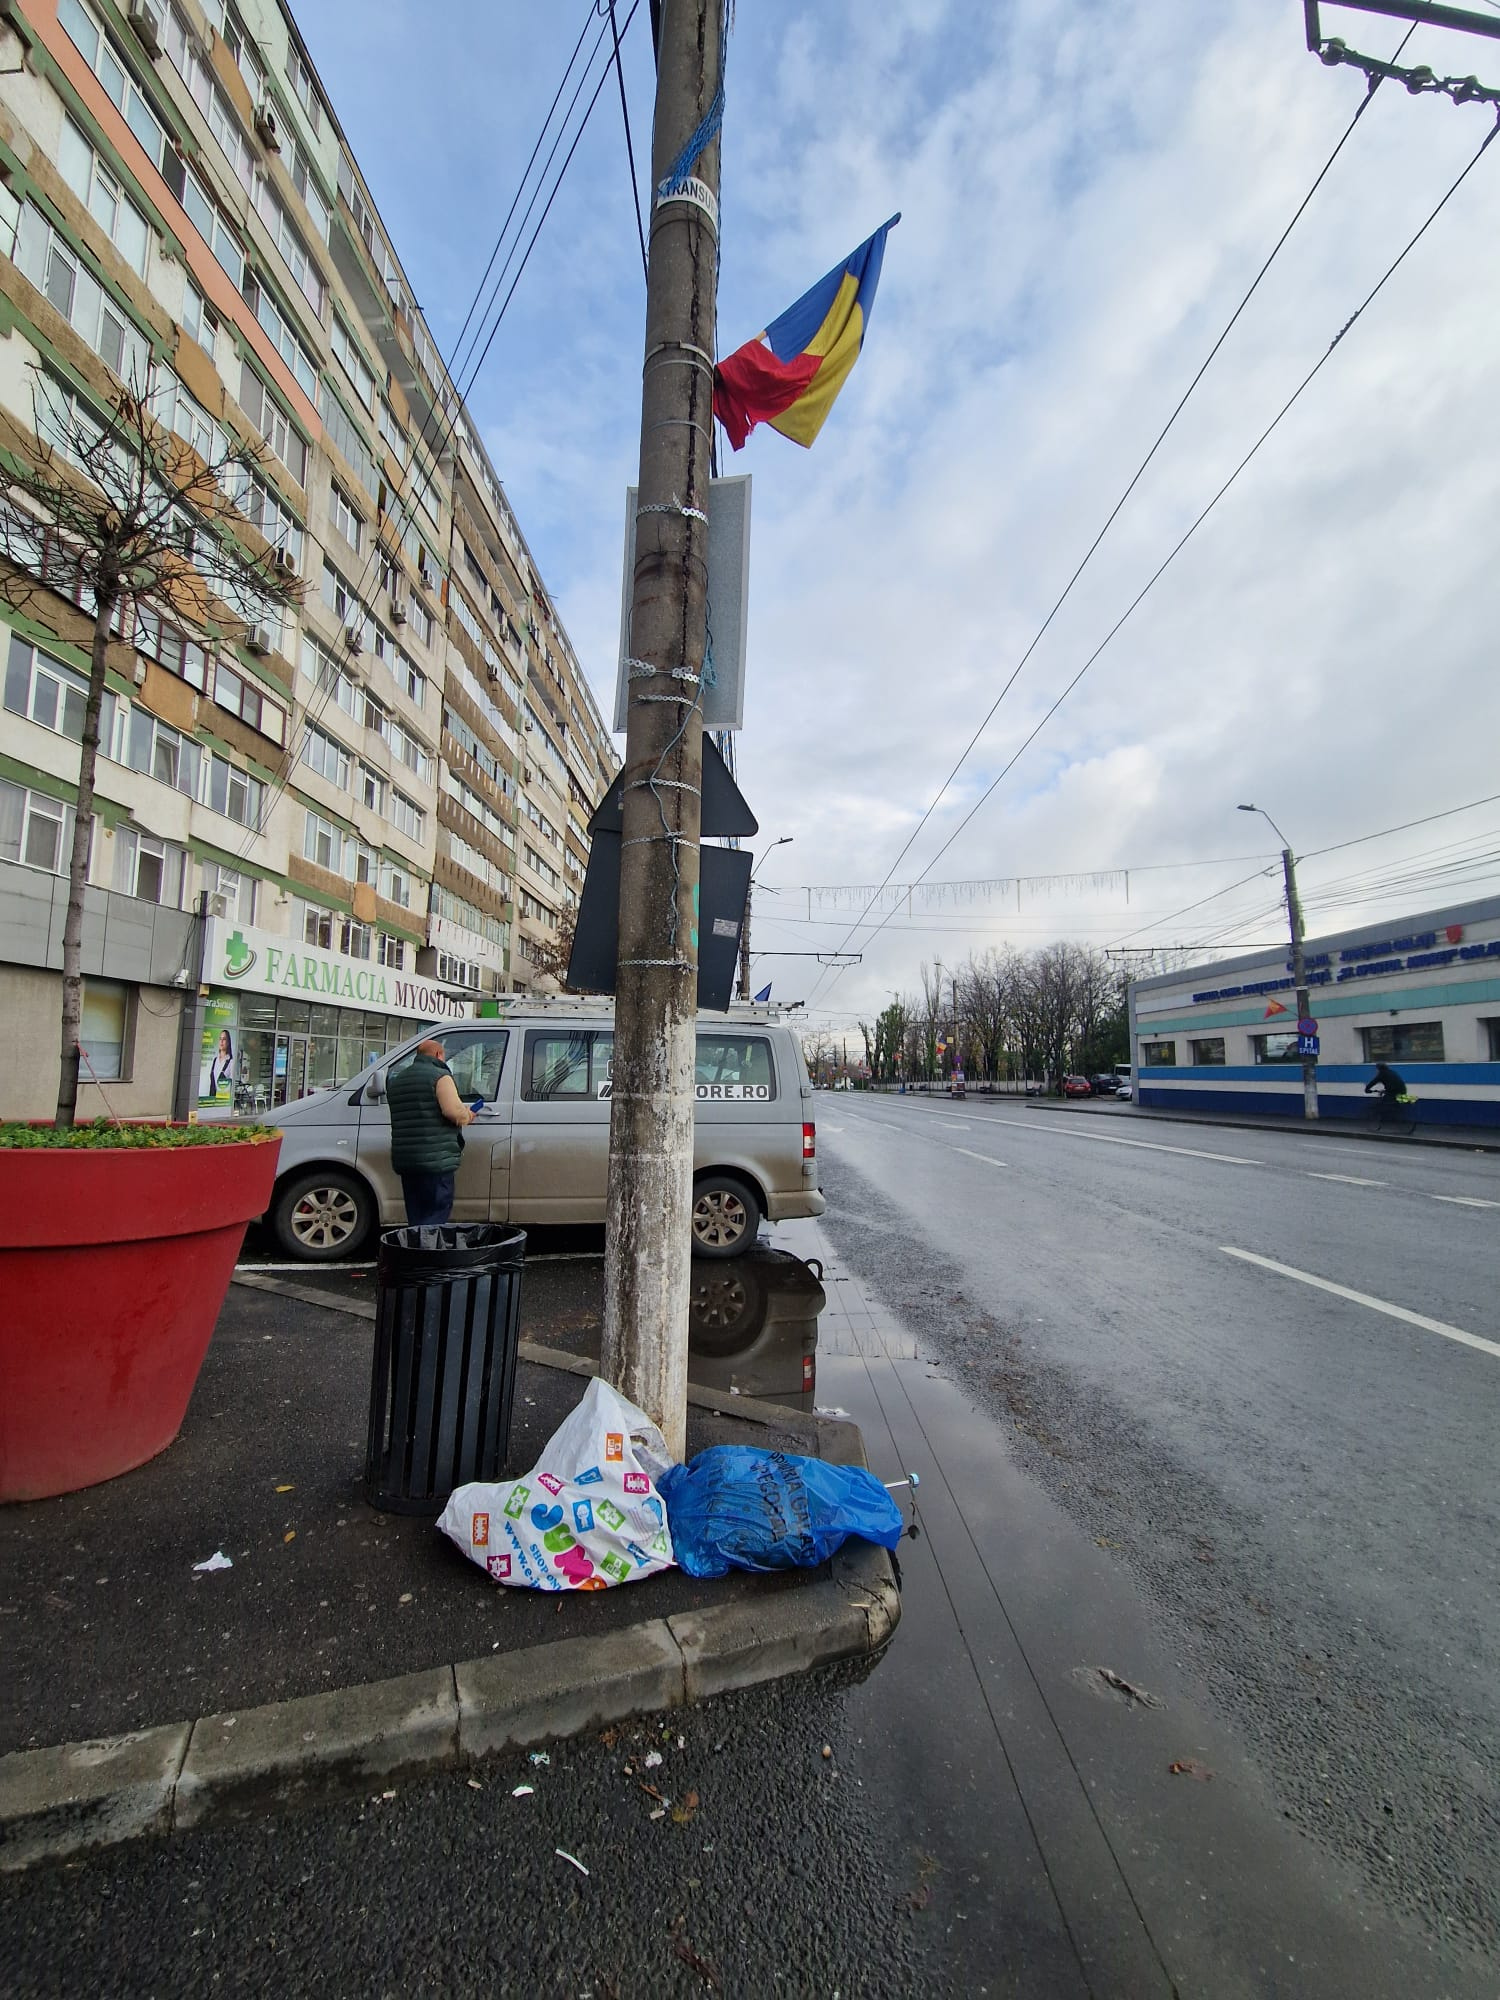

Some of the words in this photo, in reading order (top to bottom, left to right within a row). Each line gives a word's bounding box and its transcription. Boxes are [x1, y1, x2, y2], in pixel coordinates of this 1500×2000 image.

[264, 947, 388, 1005] FARMACIA
[1304, 1036, 1314, 1048] H
[696, 1085, 768, 1099] ORE.RO
[530, 1543, 549, 1574] SHOP
